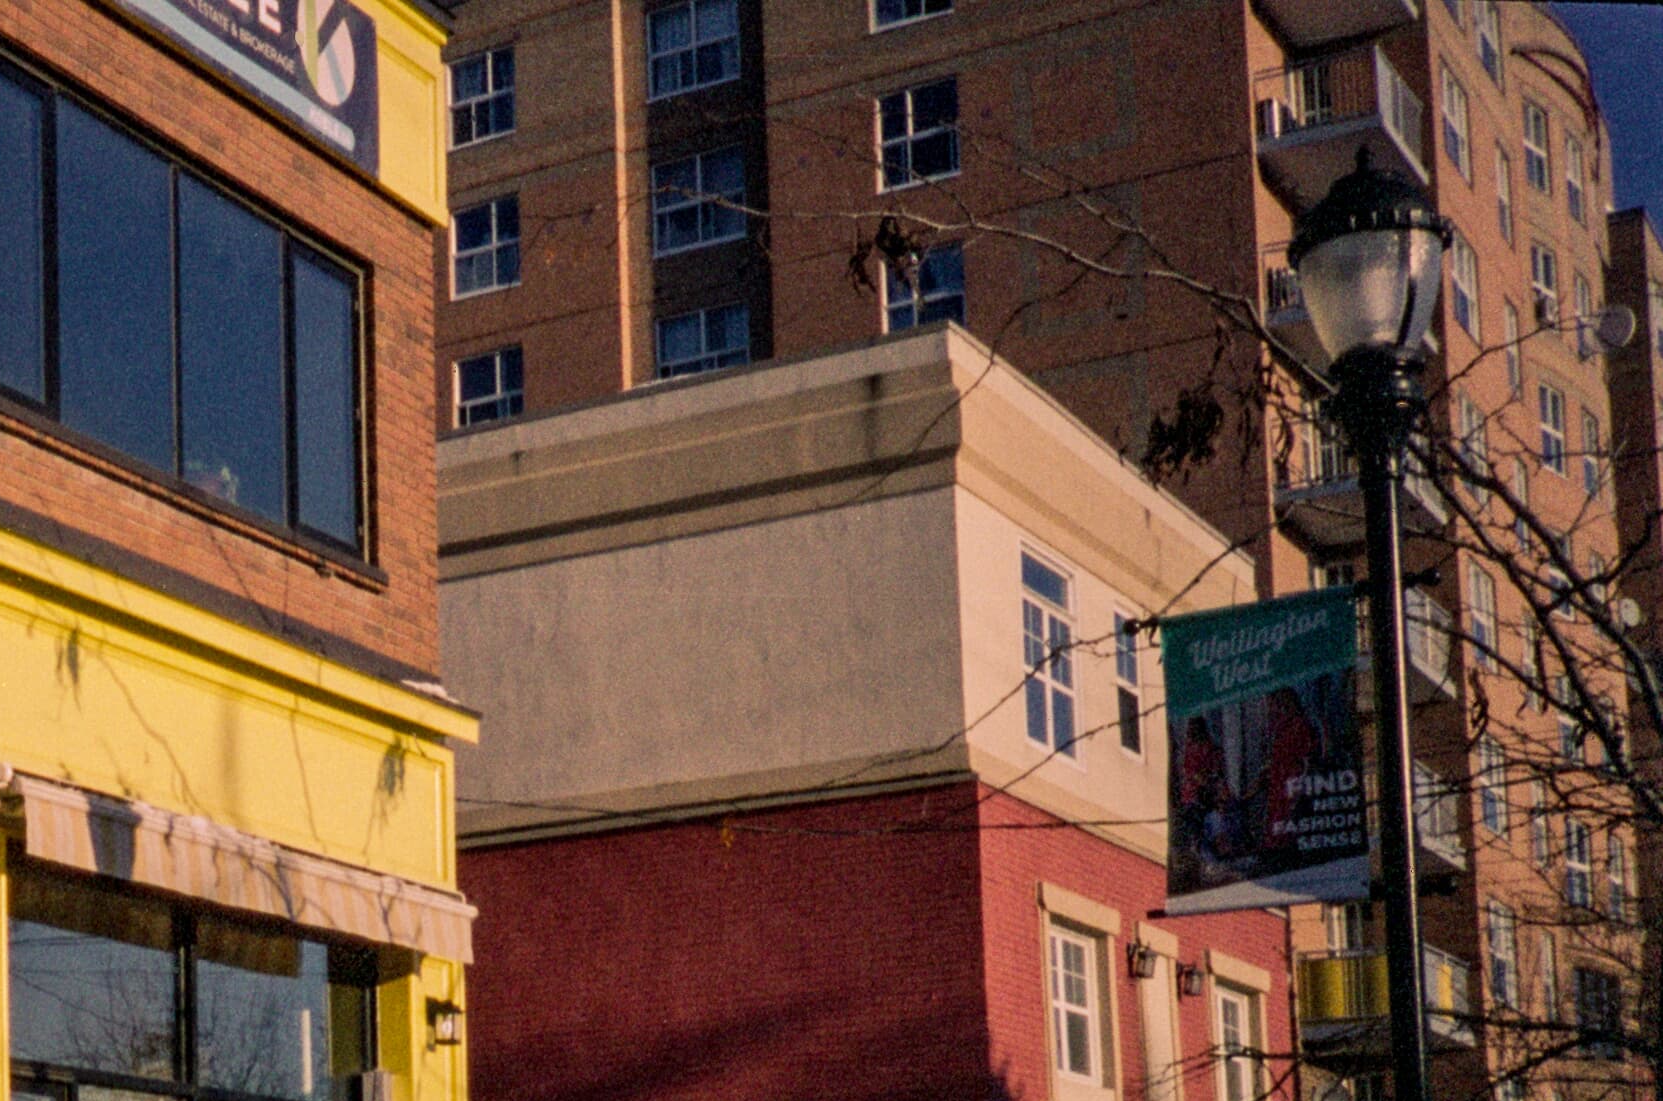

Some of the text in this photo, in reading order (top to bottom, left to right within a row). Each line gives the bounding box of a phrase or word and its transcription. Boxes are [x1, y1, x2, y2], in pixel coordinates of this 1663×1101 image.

[239, 28, 295, 74] BROKERAGE
[1192, 609, 1330, 669] Wellington
[1211, 651, 1272, 692] West
[1287, 771, 1357, 798] FIND
[1313, 797, 1359, 812] NEW
[1273, 813, 1361, 835] FASHION
[1298, 832, 1362, 851] SENSE
